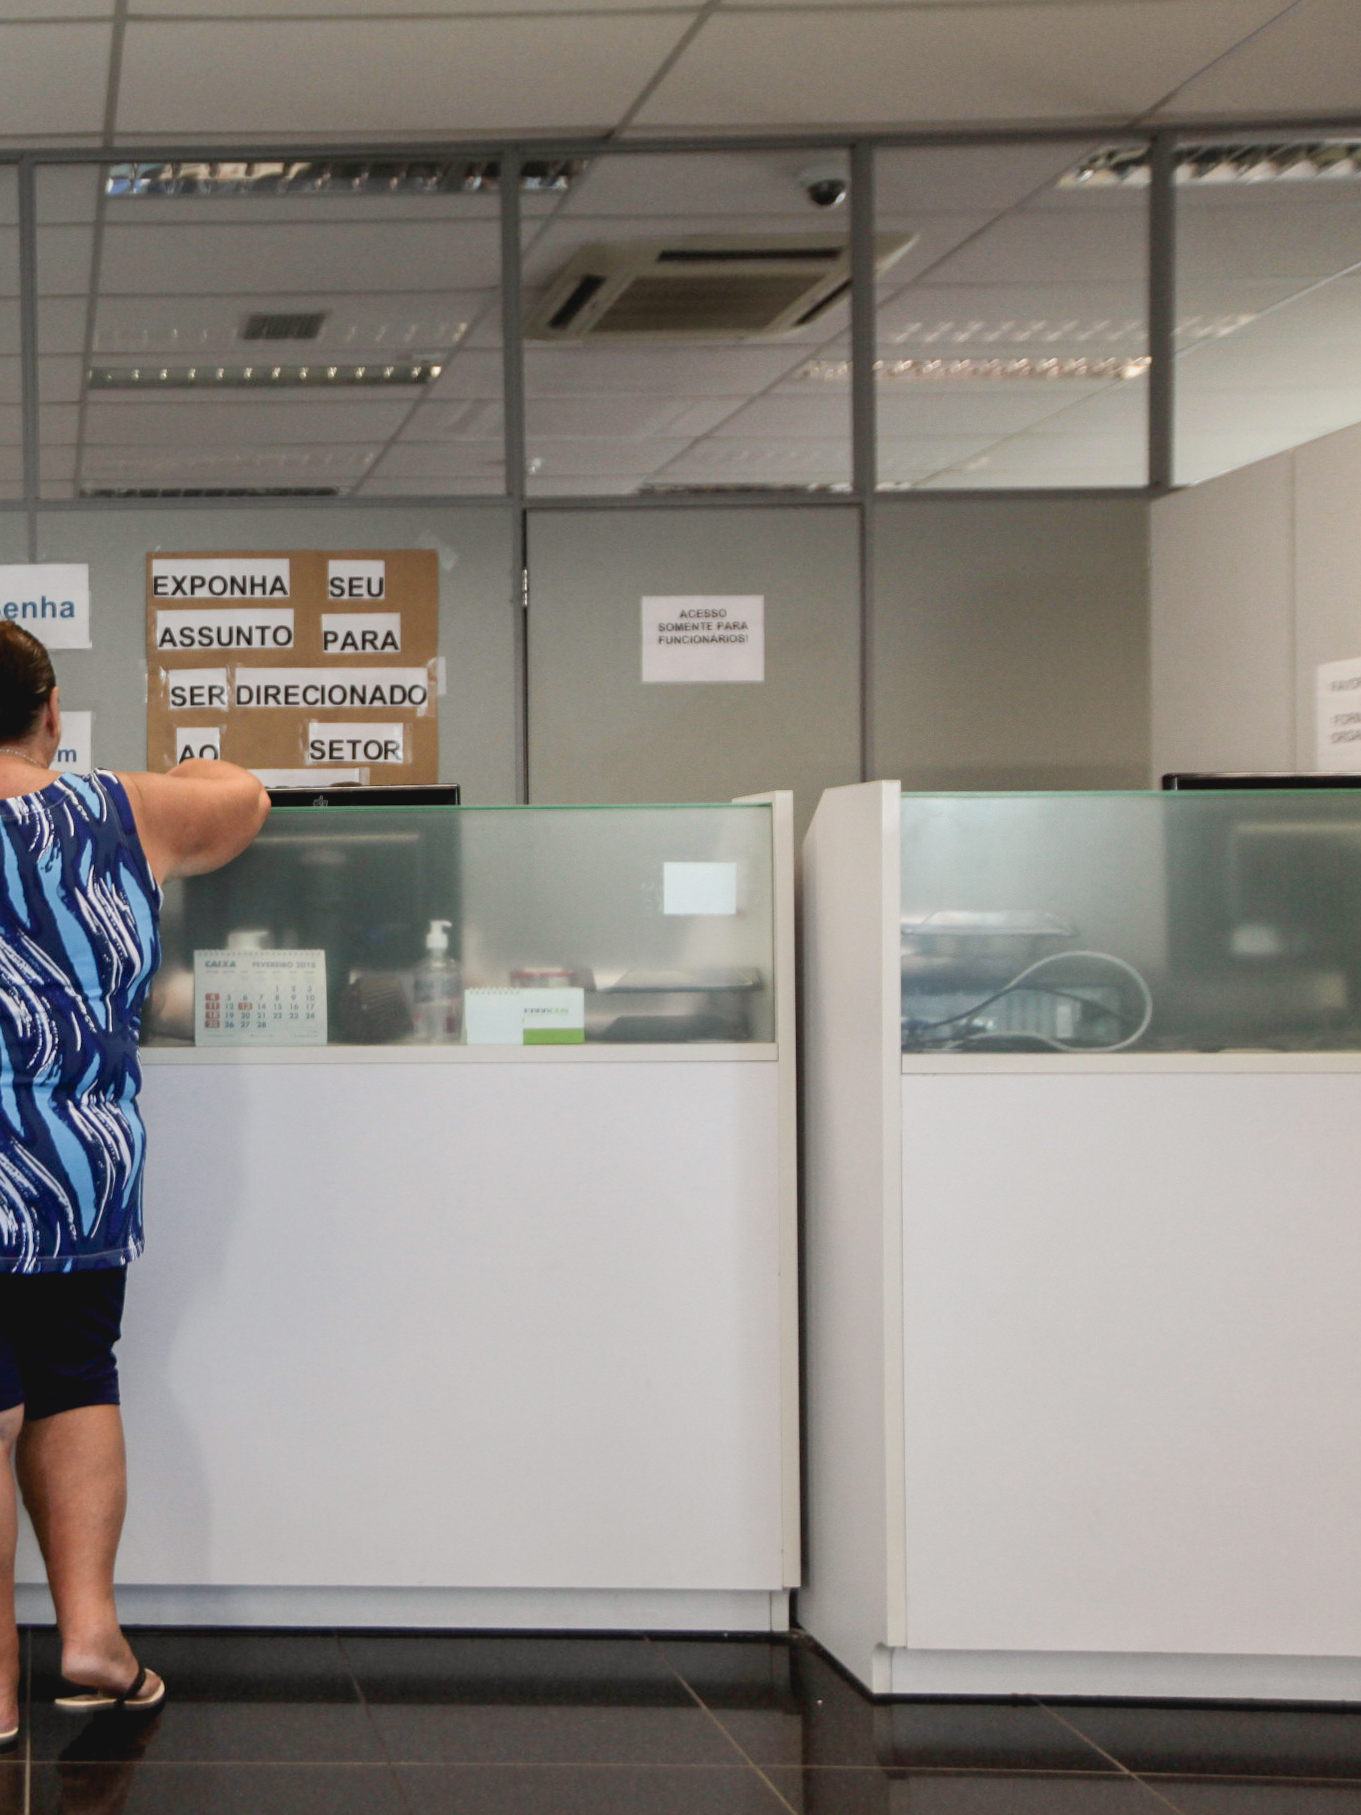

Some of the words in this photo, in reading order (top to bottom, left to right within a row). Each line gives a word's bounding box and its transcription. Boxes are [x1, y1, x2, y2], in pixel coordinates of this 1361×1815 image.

[153, 575, 289, 596] EXPONHA
[329, 576, 384, 598] SEU
[679, 608, 727, 619] ACESSO
[158, 625, 293, 648] ASSUNTO
[323, 630, 400, 651] PARA
[658, 621, 713, 632] SOMENTE
[717, 621, 748, 631] PARA
[171, 685, 226, 707] SER
[236, 684, 427, 706] DIRECIONADO
[179, 744, 219, 764] AO
[310, 739, 401, 761] SETOR
[204, 960, 236, 968] CAIXA
